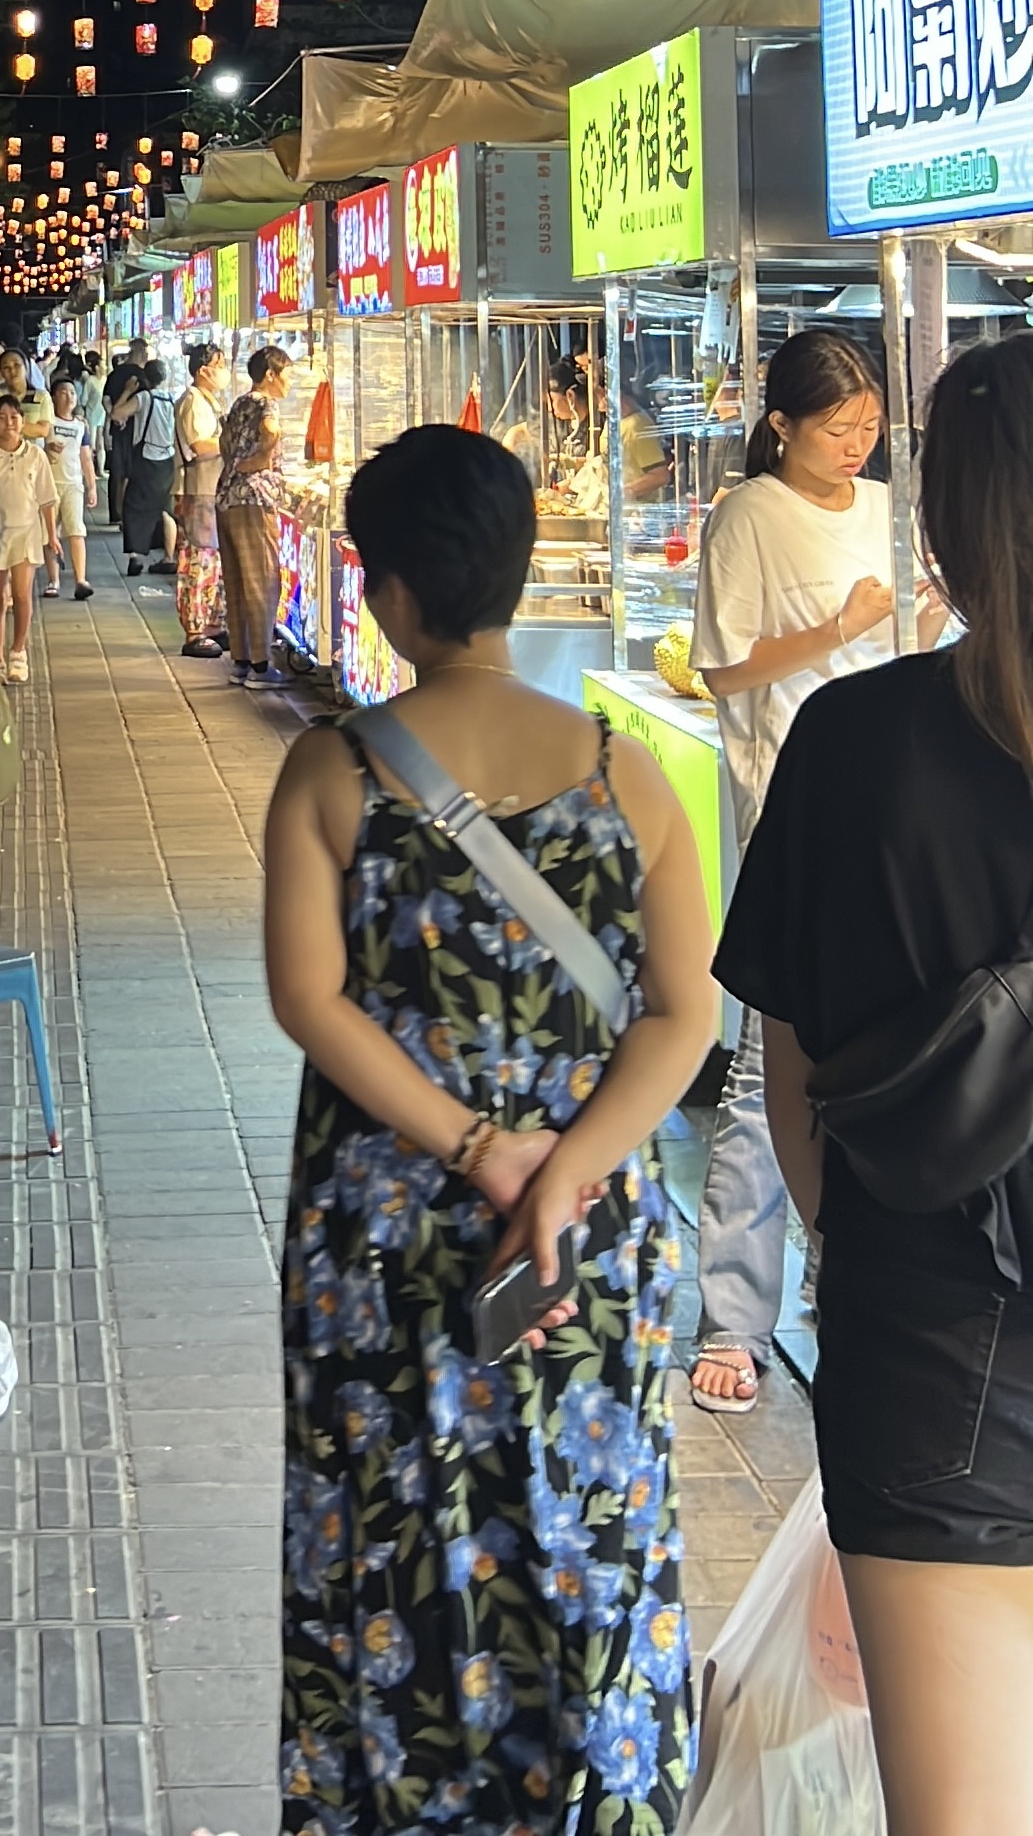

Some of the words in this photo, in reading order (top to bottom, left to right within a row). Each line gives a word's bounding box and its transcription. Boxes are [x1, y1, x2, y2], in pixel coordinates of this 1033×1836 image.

[608, 63, 693, 204] 烤榴莲
[538, 194, 552, 254] SUS304
